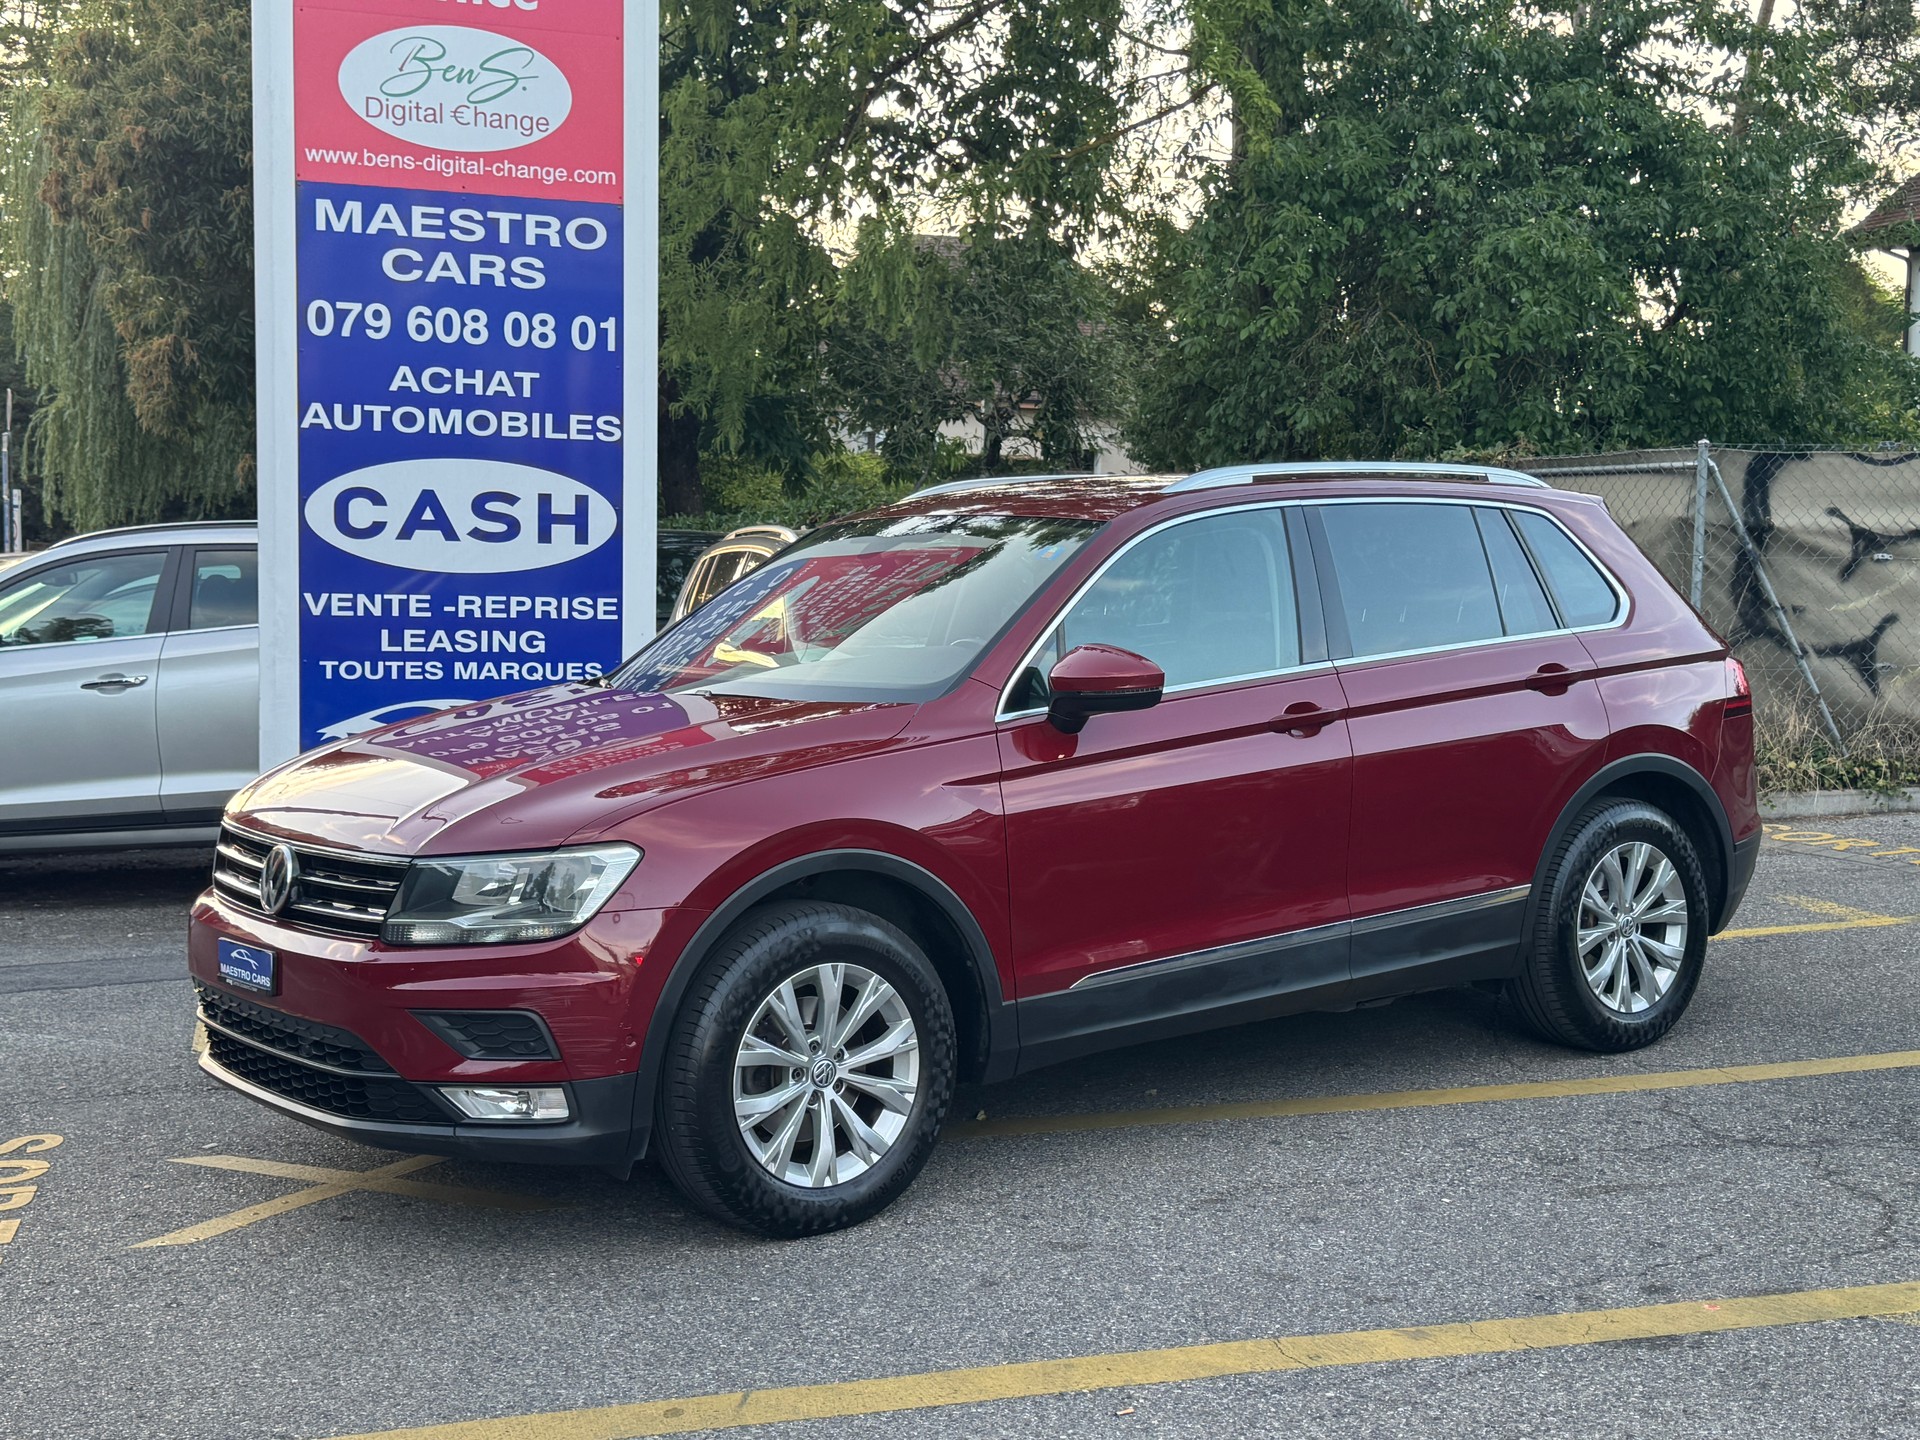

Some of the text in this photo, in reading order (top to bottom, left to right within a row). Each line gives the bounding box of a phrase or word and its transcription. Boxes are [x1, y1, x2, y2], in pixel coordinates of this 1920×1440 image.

[365, 96, 444, 126] Digital
[305, 146, 617, 186] www.bens-digital-change.com
[315, 198, 607, 250] MAESTRO
[382, 248, 546, 289] CARS
[307, 300, 617, 351] 079 608 08 01
[389, 365, 540, 397] ACHAT
[301, 402, 622, 442] AUTOMOBILES
[334, 487, 589, 545] CASH
[304, 593, 432, 617] VENTE
[381, 629, 545, 653] LEASING
[319, 661, 602, 682] TOUTES MARQUES
[220, 962, 251, 981] MAESTRO
[252, 972, 271, 987] CARS
